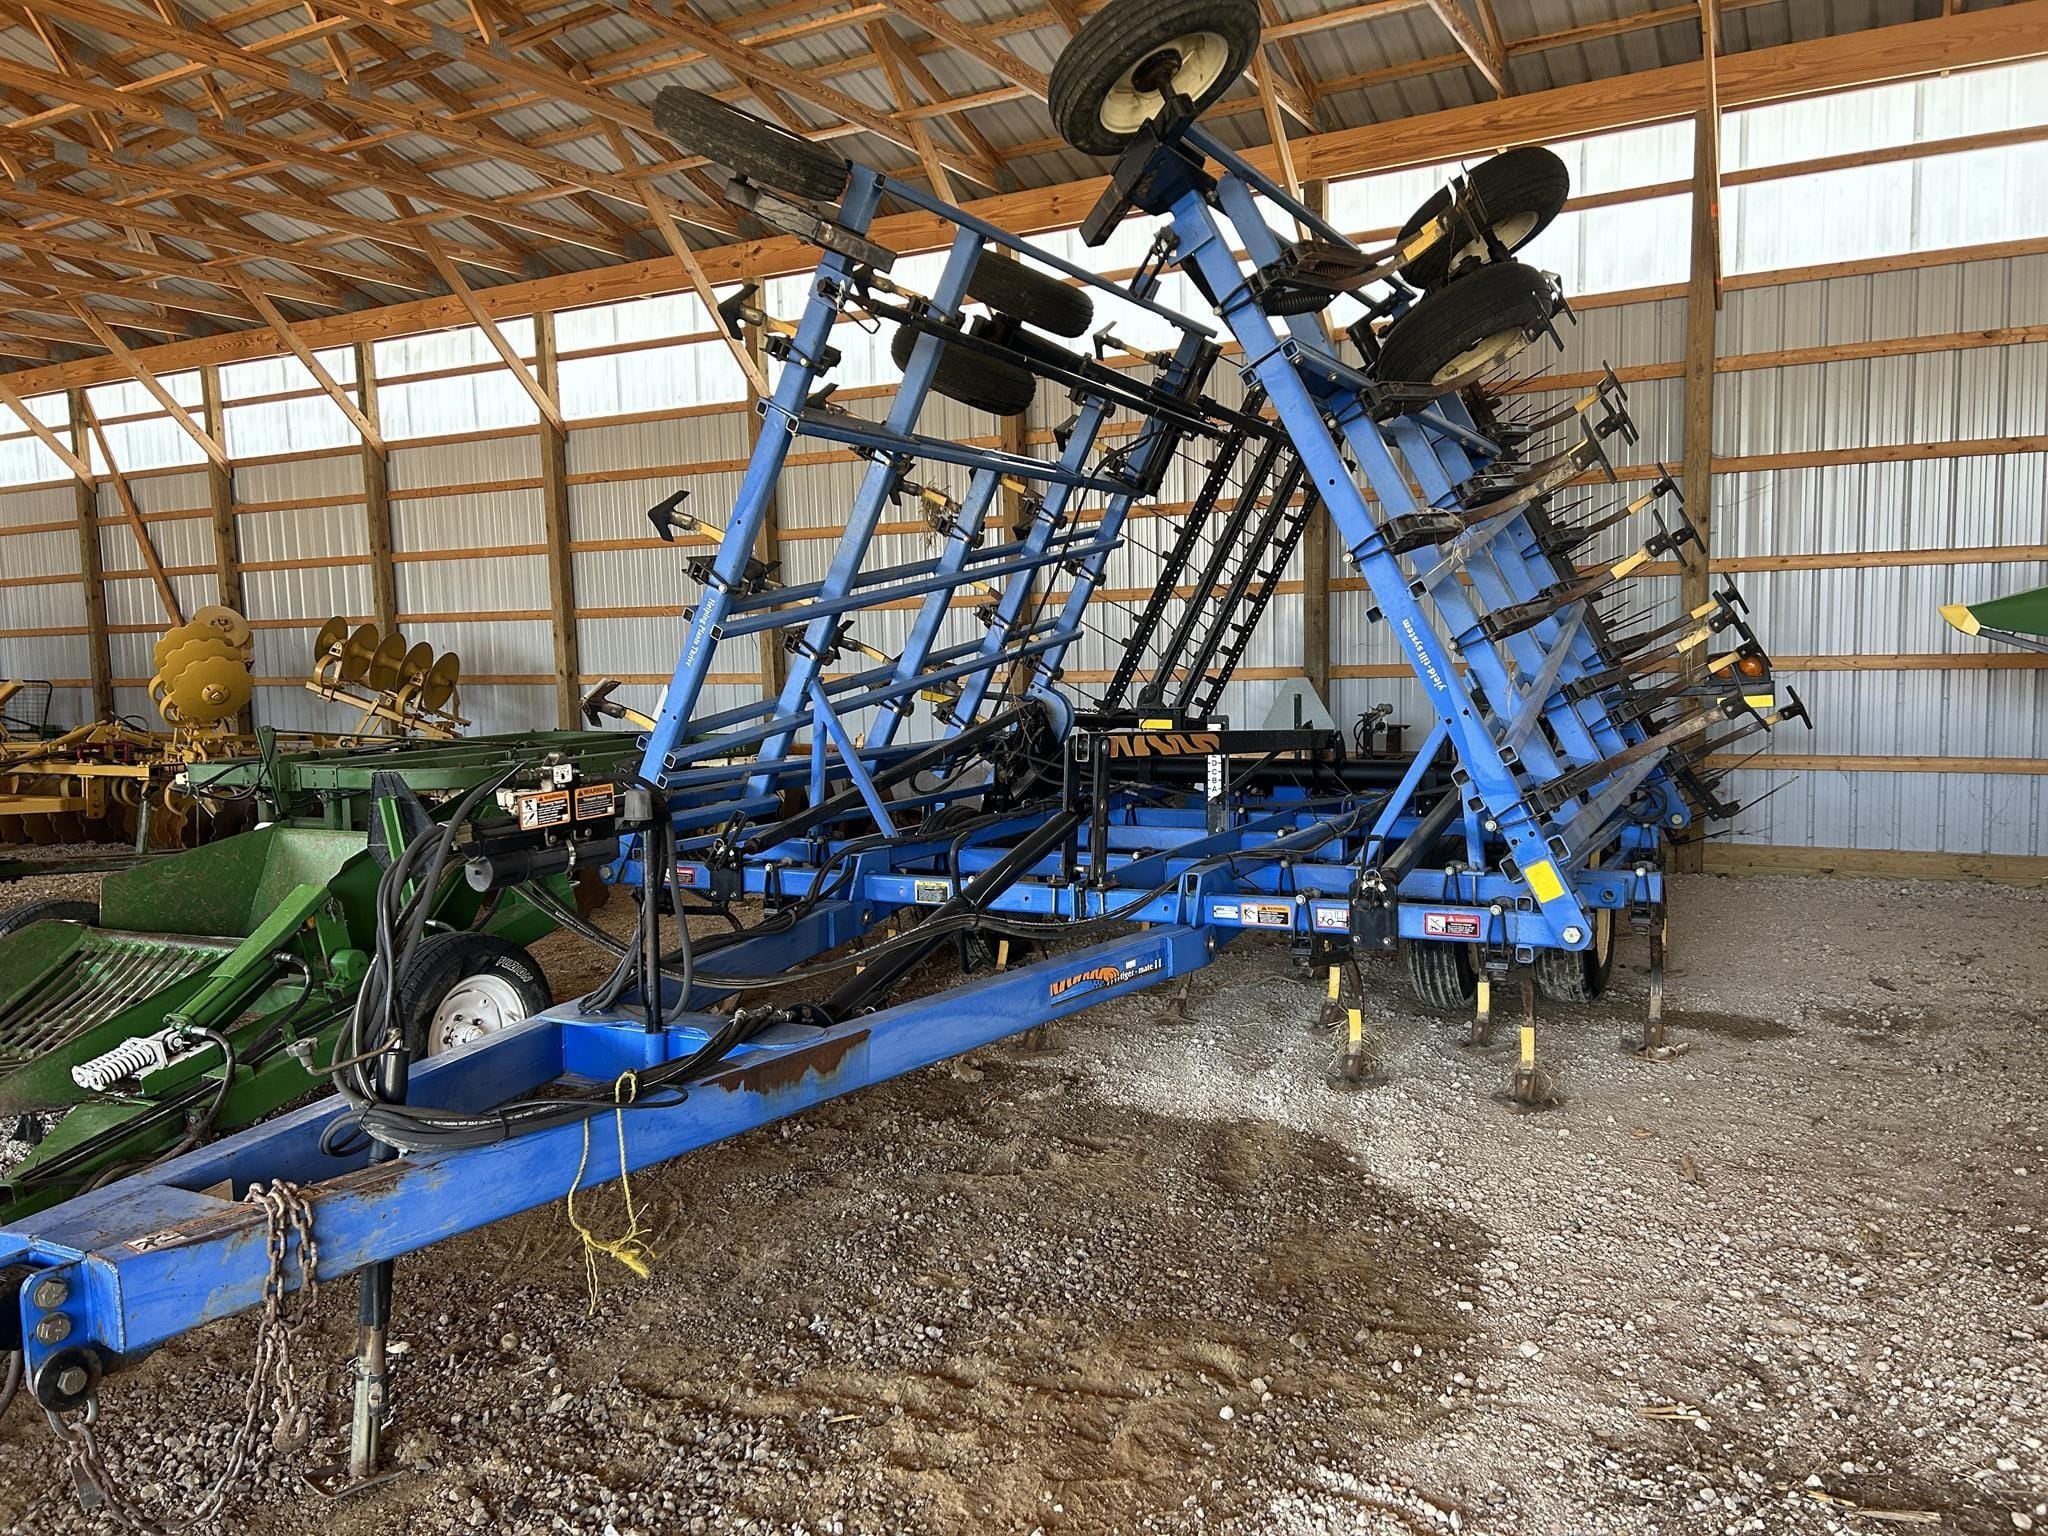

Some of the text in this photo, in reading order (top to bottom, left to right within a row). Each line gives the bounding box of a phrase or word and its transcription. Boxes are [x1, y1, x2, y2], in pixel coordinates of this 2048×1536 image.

[685, 598, 716, 667] Helping Plants Thrive
[1402, 619, 1424, 652] system
[544, 792, 567, 800] WARNING
[584, 786, 612, 794] WARNING
